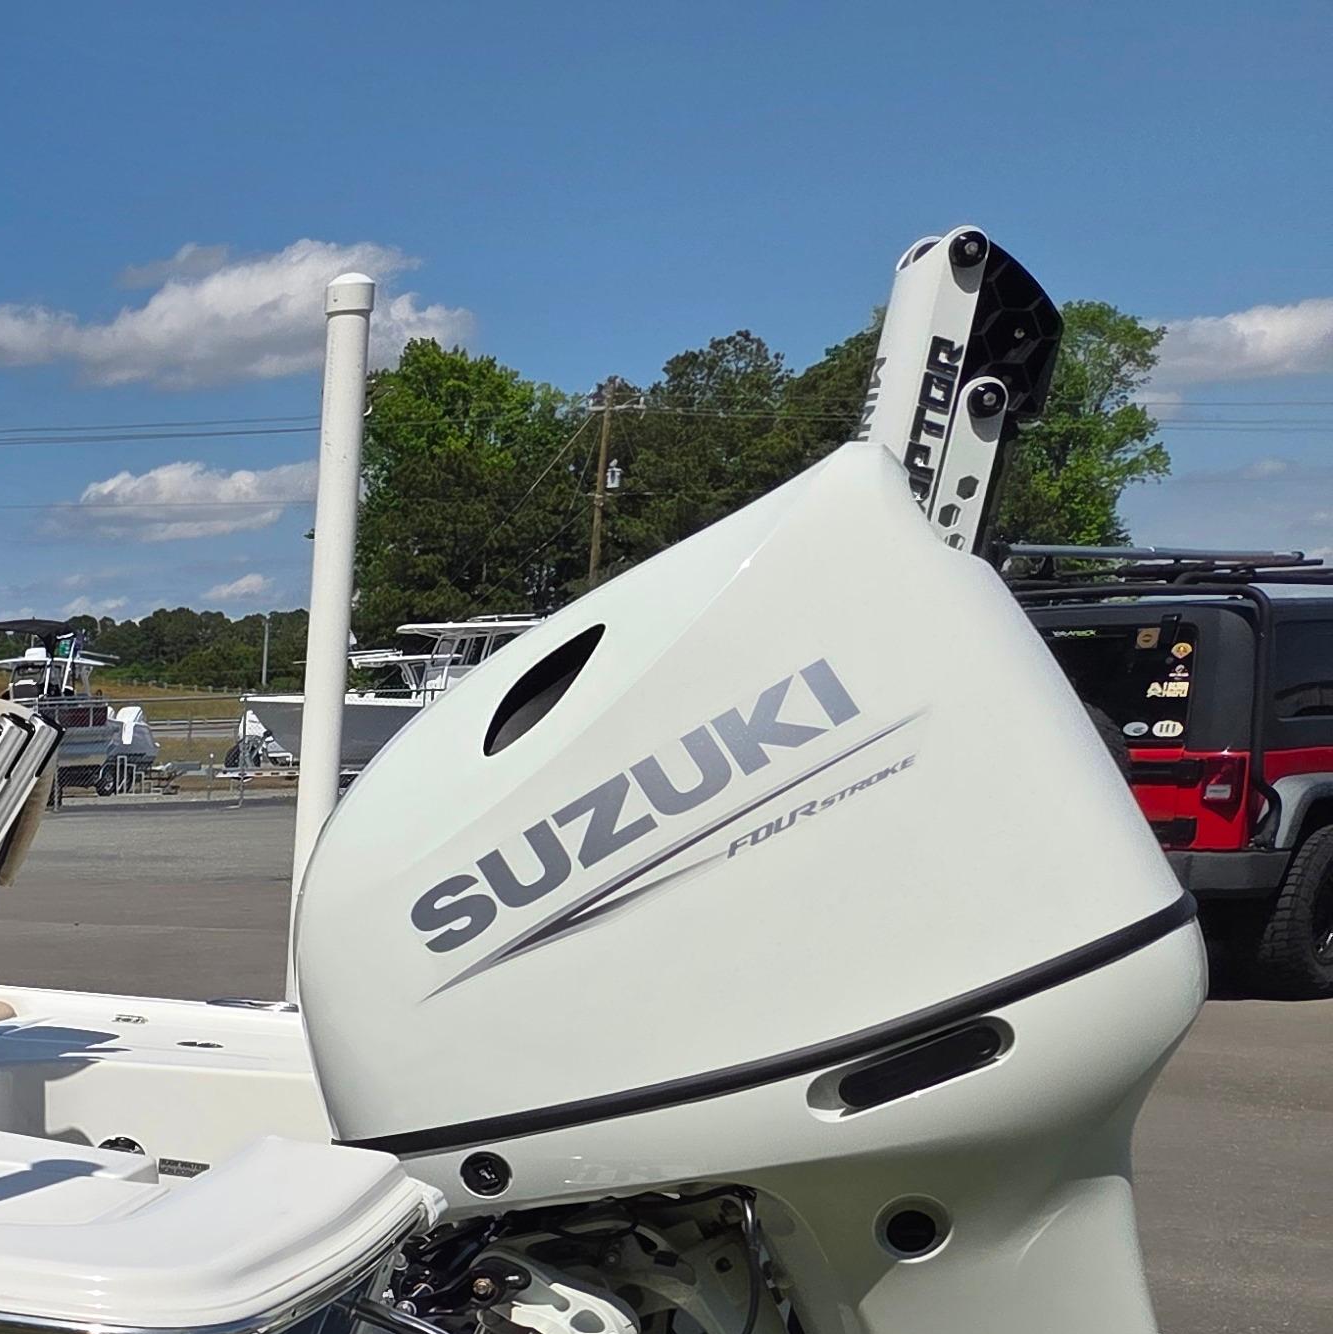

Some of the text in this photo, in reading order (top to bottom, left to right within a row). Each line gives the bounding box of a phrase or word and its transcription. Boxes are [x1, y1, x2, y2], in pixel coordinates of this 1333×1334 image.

[410, 658, 861, 953] SUZUKI
[727, 754, 916, 859] FOUR STROKE
